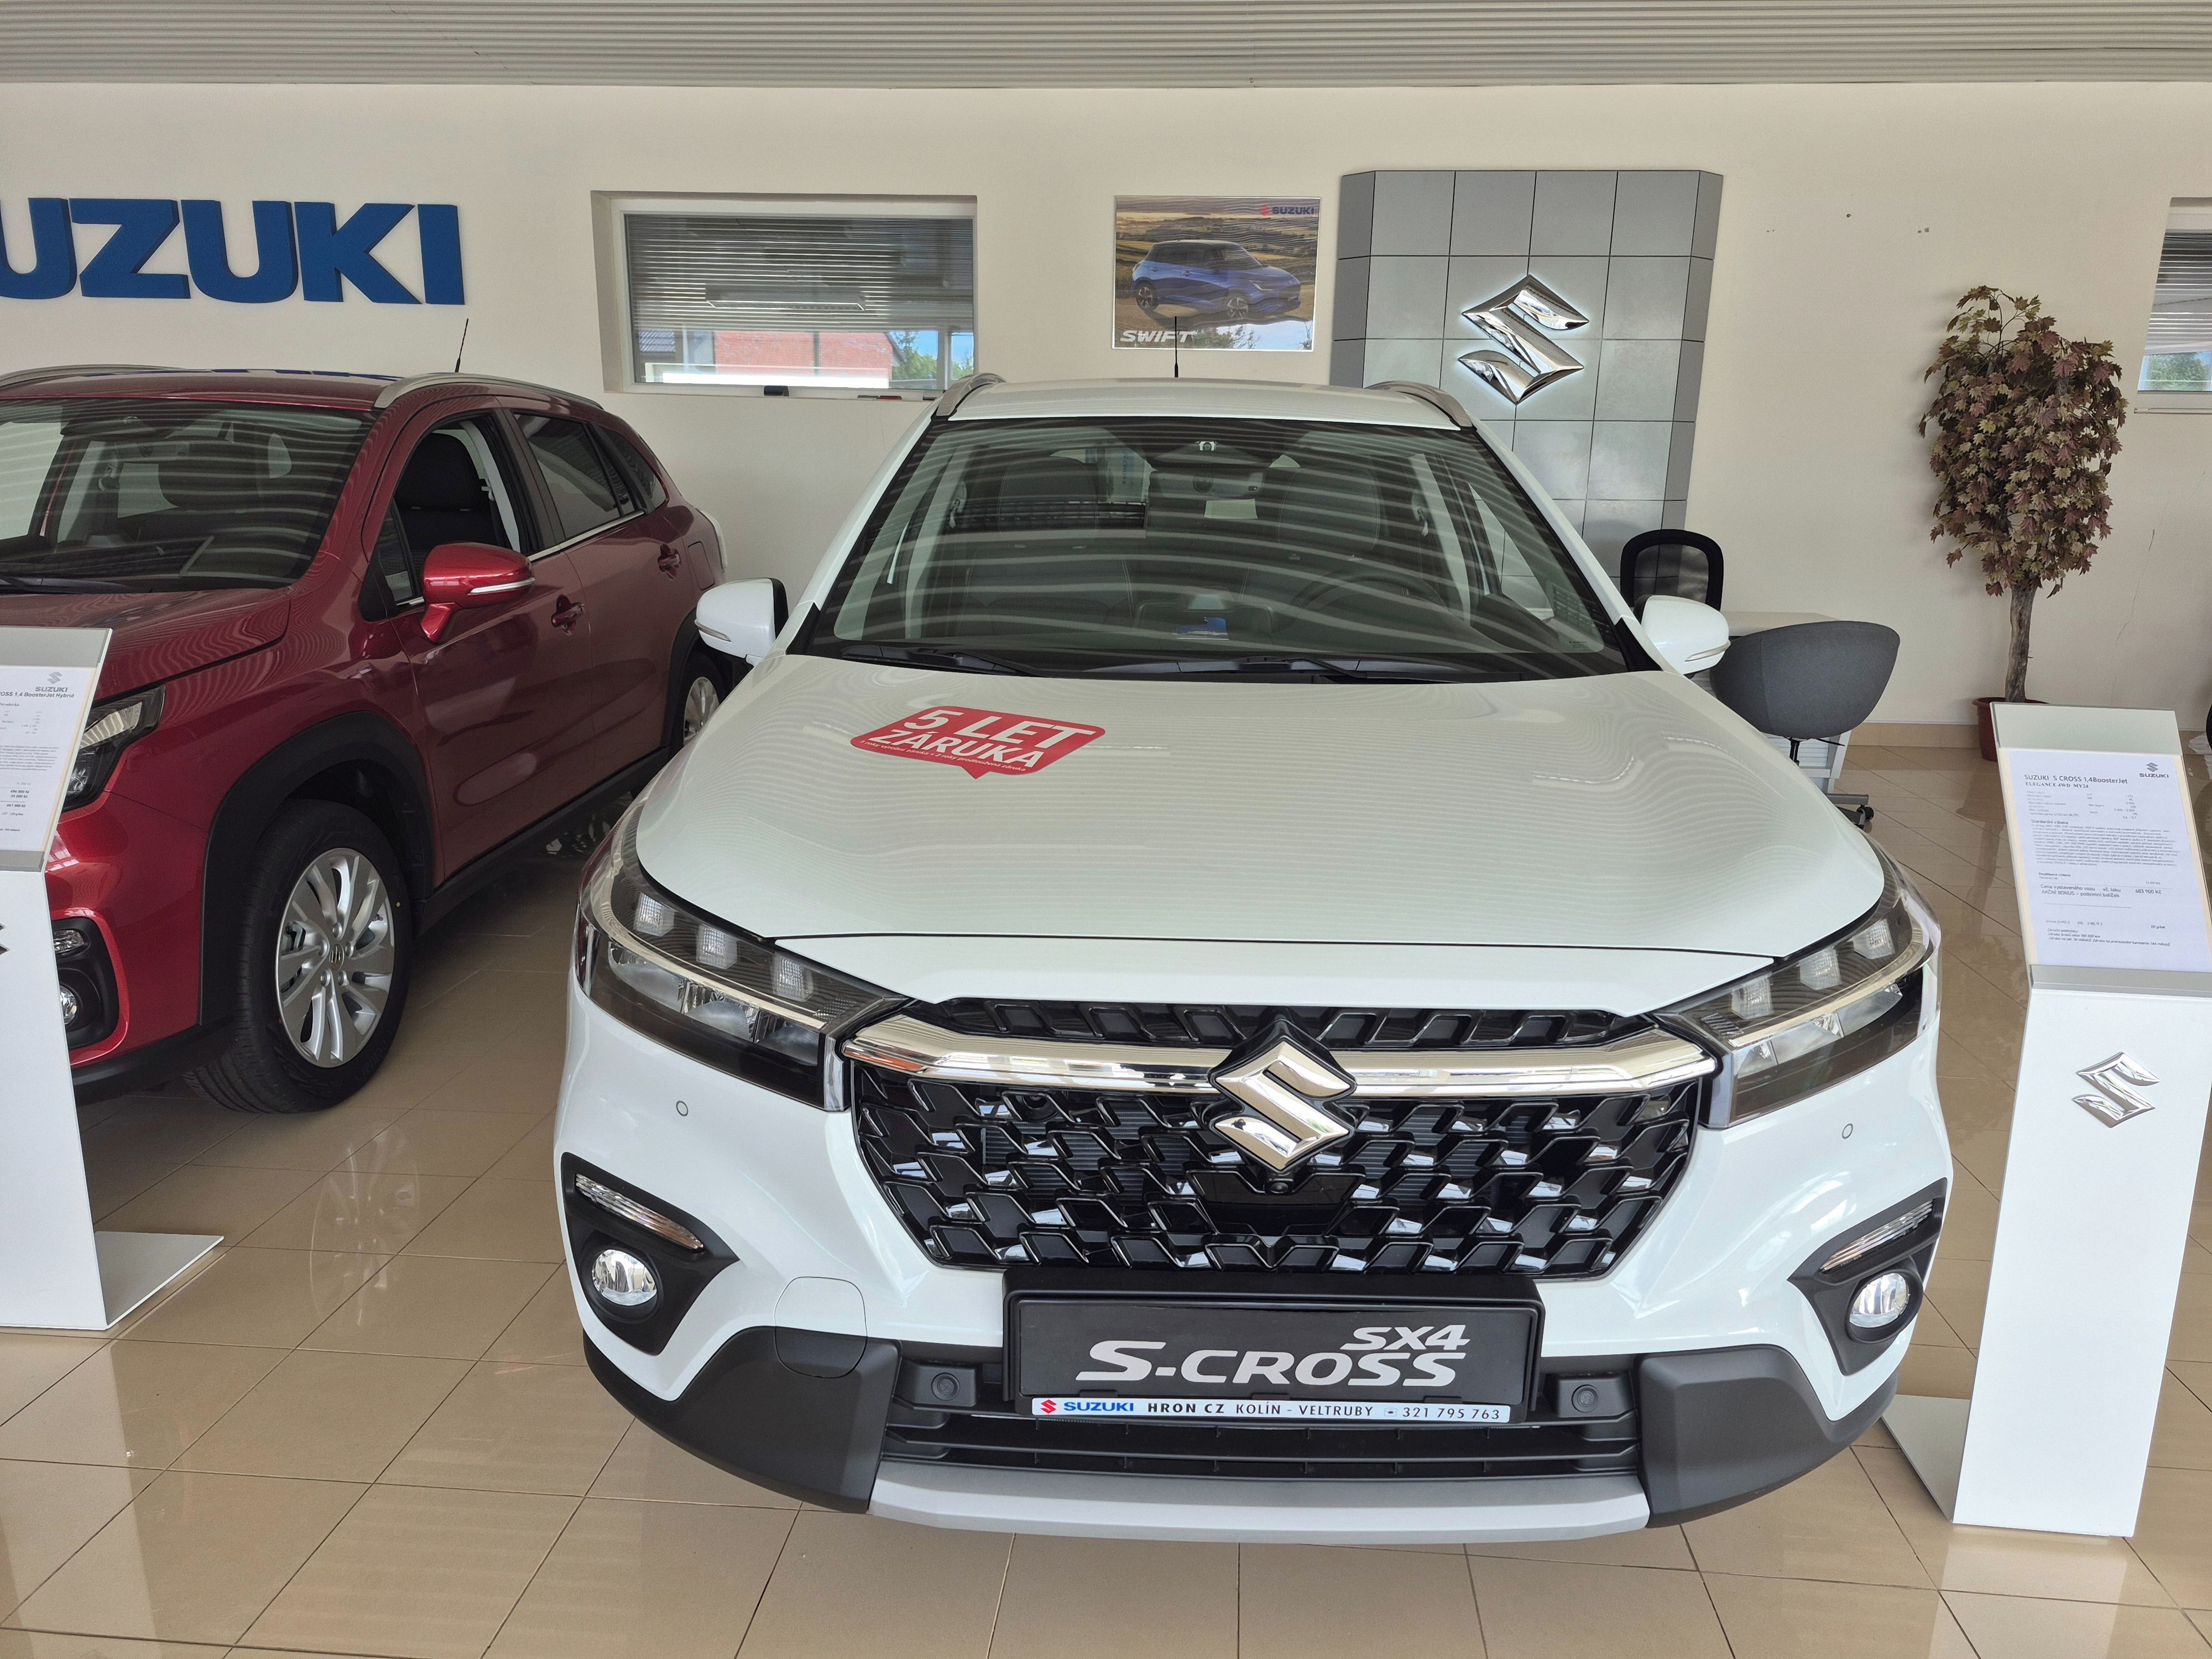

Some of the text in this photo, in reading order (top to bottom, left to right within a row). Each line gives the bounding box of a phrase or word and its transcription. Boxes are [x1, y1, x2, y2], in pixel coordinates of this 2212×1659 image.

[1272, 206, 1314, 215] SUZUKI
[1120, 330, 1193, 343] SWIFT
[904, 709, 1096, 749] 5 LET
[868, 729, 1045, 768] ZÁRUKA
[1339, 1324, 1471, 1351] SX4
[1075, 1339, 1467, 1387] S-CROSS
[1063, 1401, 1134, 1412] SUZUKI
[1147, 1402, 1196, 1413] HRON
[1204, 1404, 1225, 1414] CZ
[1235, 1401, 1281, 1415] KOLÍN
[1298, 1405, 1374, 1417] VELTRUBY
[1402, 1407, 1429, 1418] 321
[1437, 1408, 1465, 1419] 795
[1472, 1408, 1500, 1420] 763
